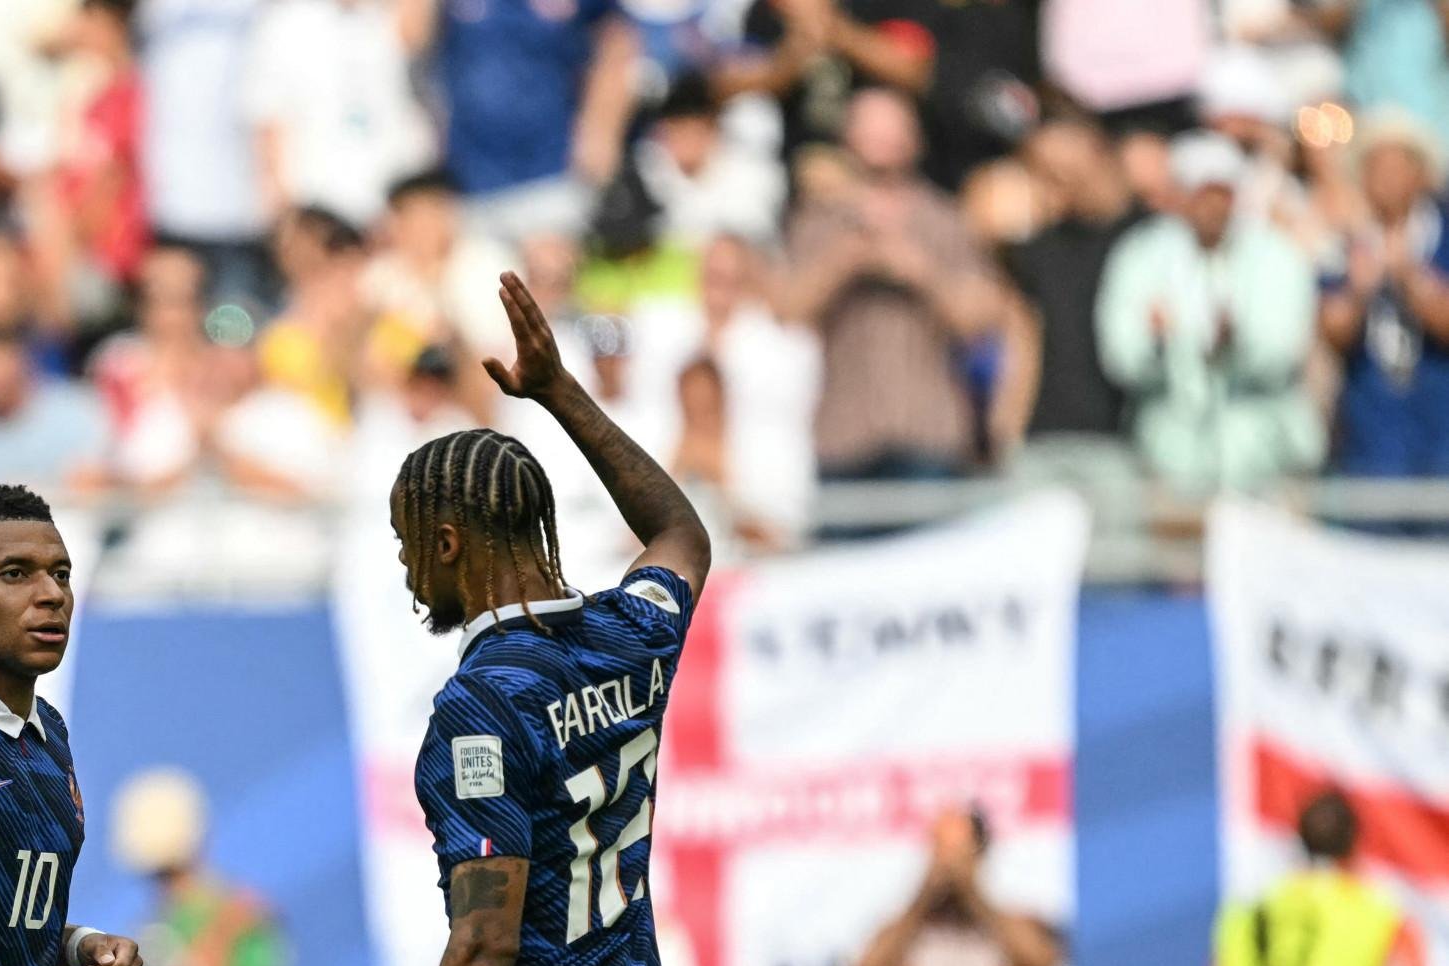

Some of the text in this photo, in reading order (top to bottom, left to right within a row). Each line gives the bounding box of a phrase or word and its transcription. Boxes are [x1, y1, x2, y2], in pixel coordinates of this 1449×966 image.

[461, 755, 493, 769] UNITES
[564, 727, 658, 944] 12
[8, 849, 60, 930] 10
